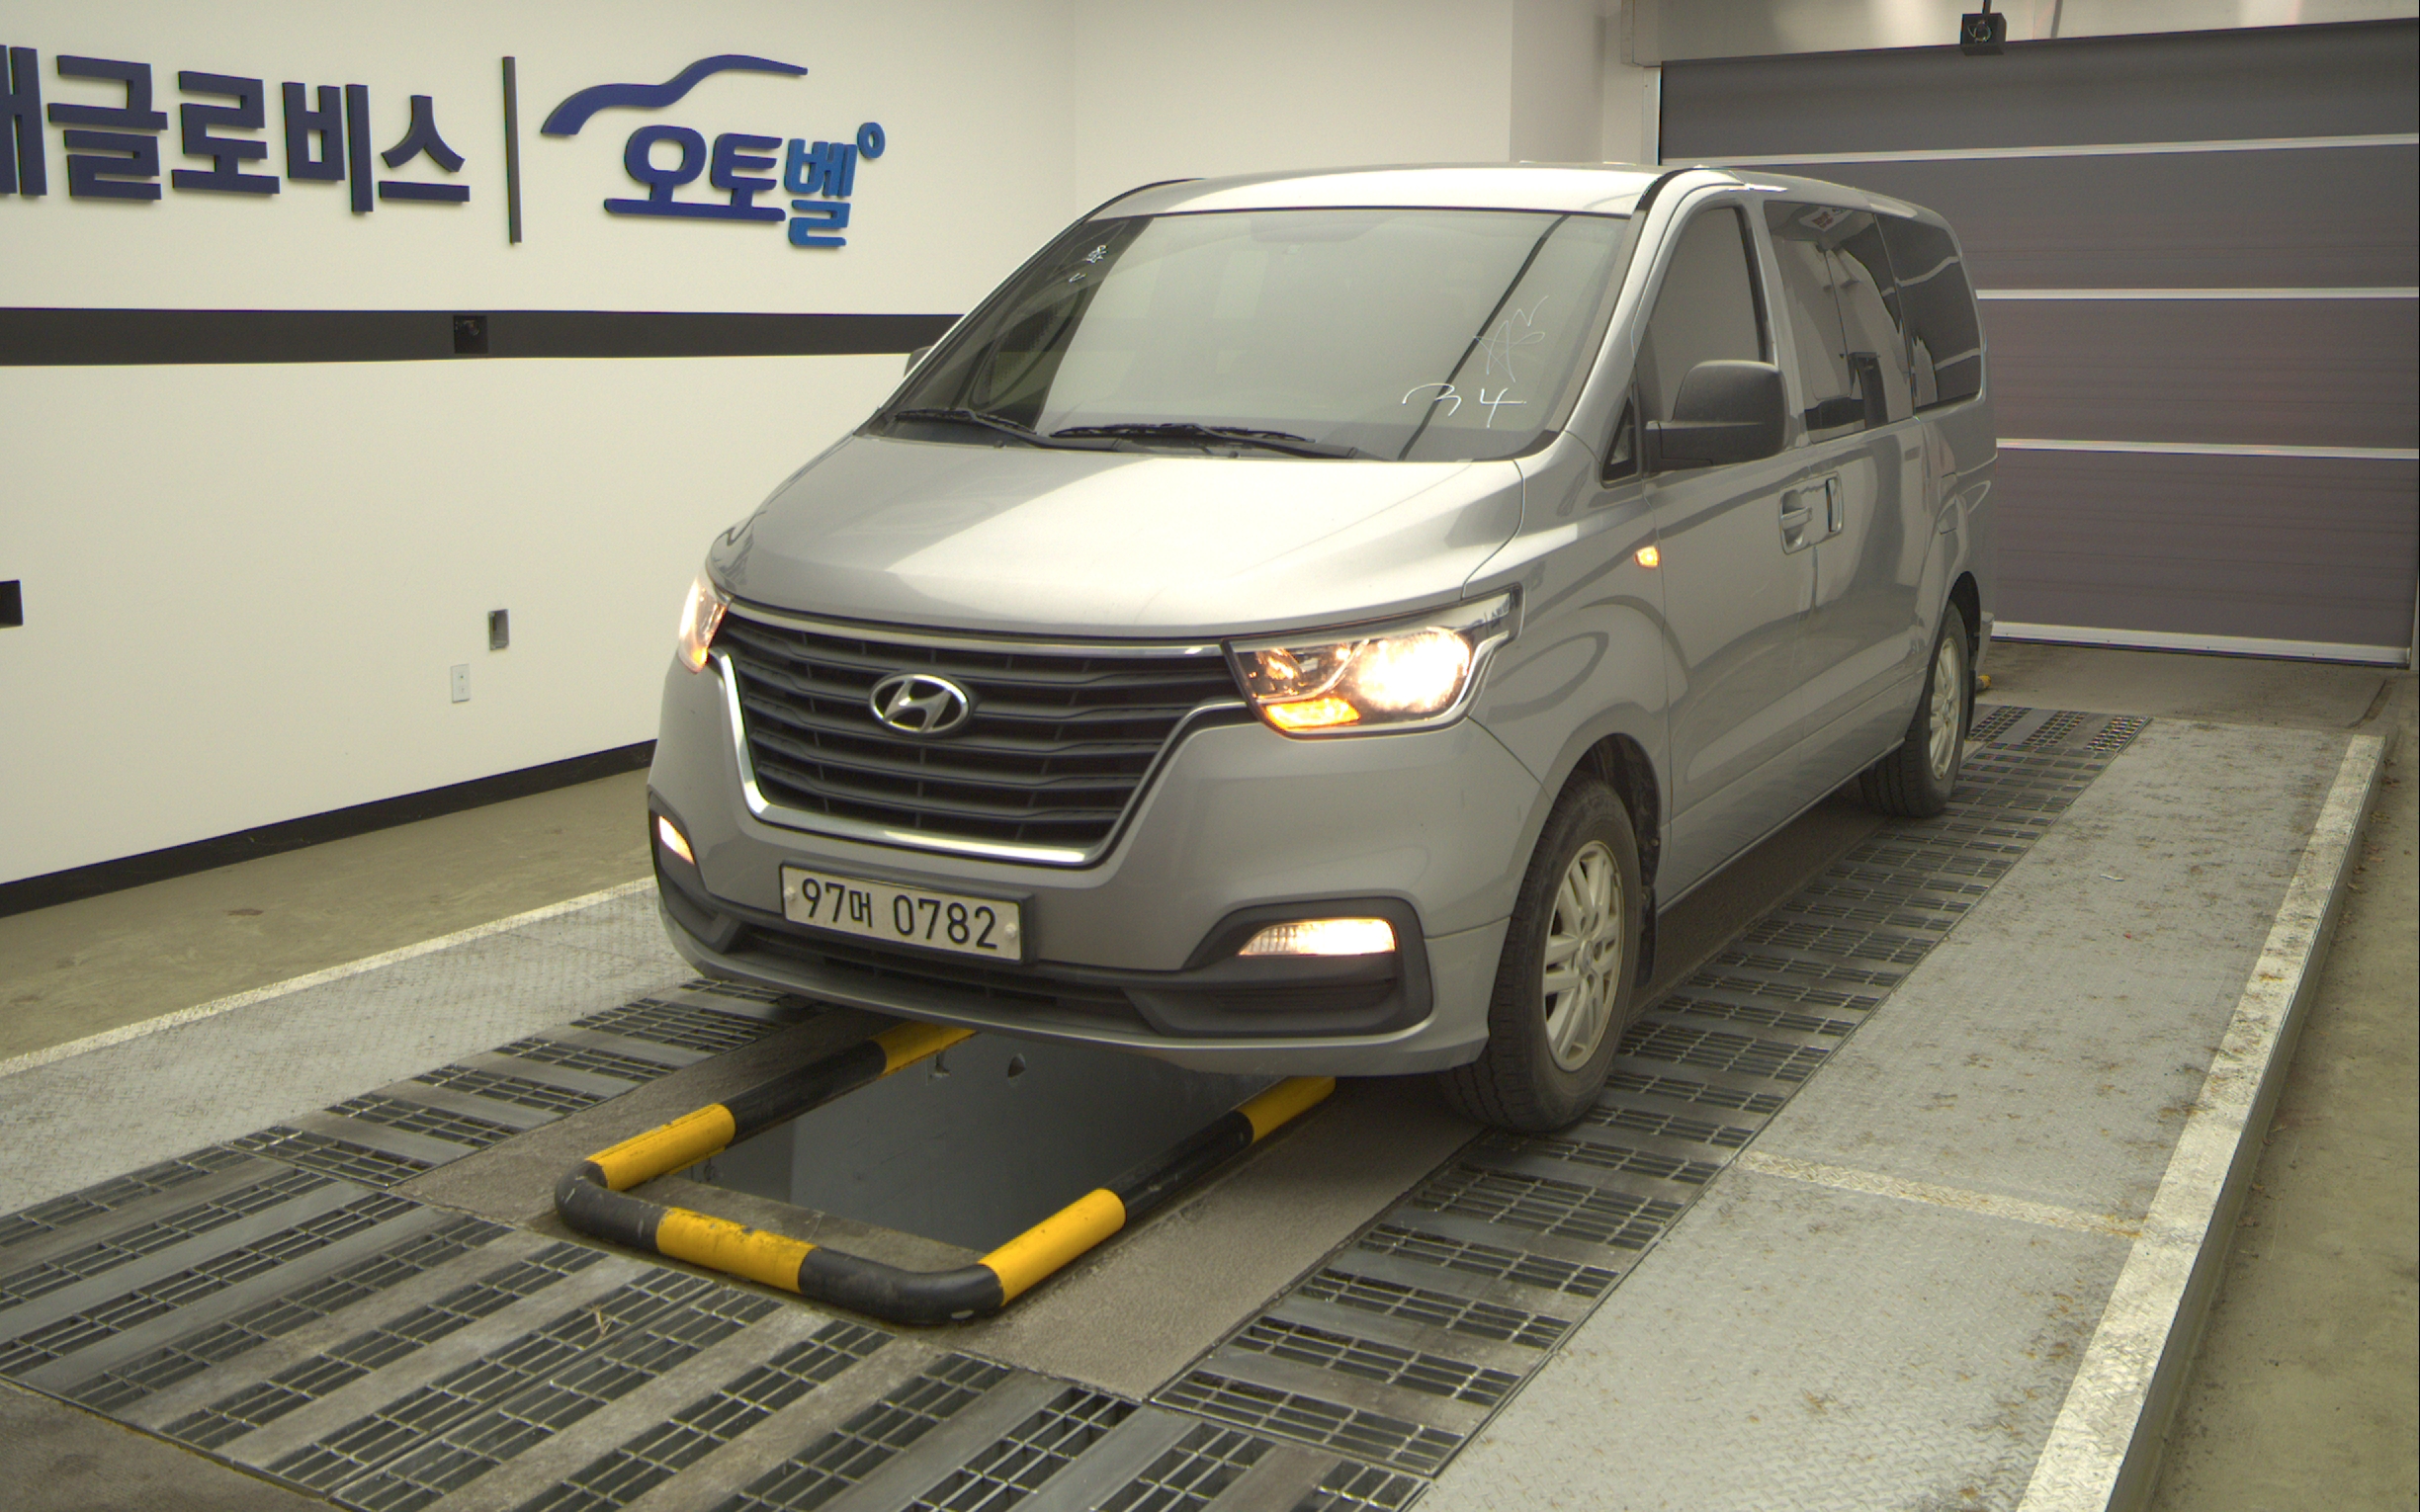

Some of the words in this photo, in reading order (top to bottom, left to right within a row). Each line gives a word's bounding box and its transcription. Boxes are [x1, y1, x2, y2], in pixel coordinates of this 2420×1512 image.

[603, 124, 859, 247] 오토벨
[802, 878, 874, 929] 97머
[893, 894, 998, 950] 0782
